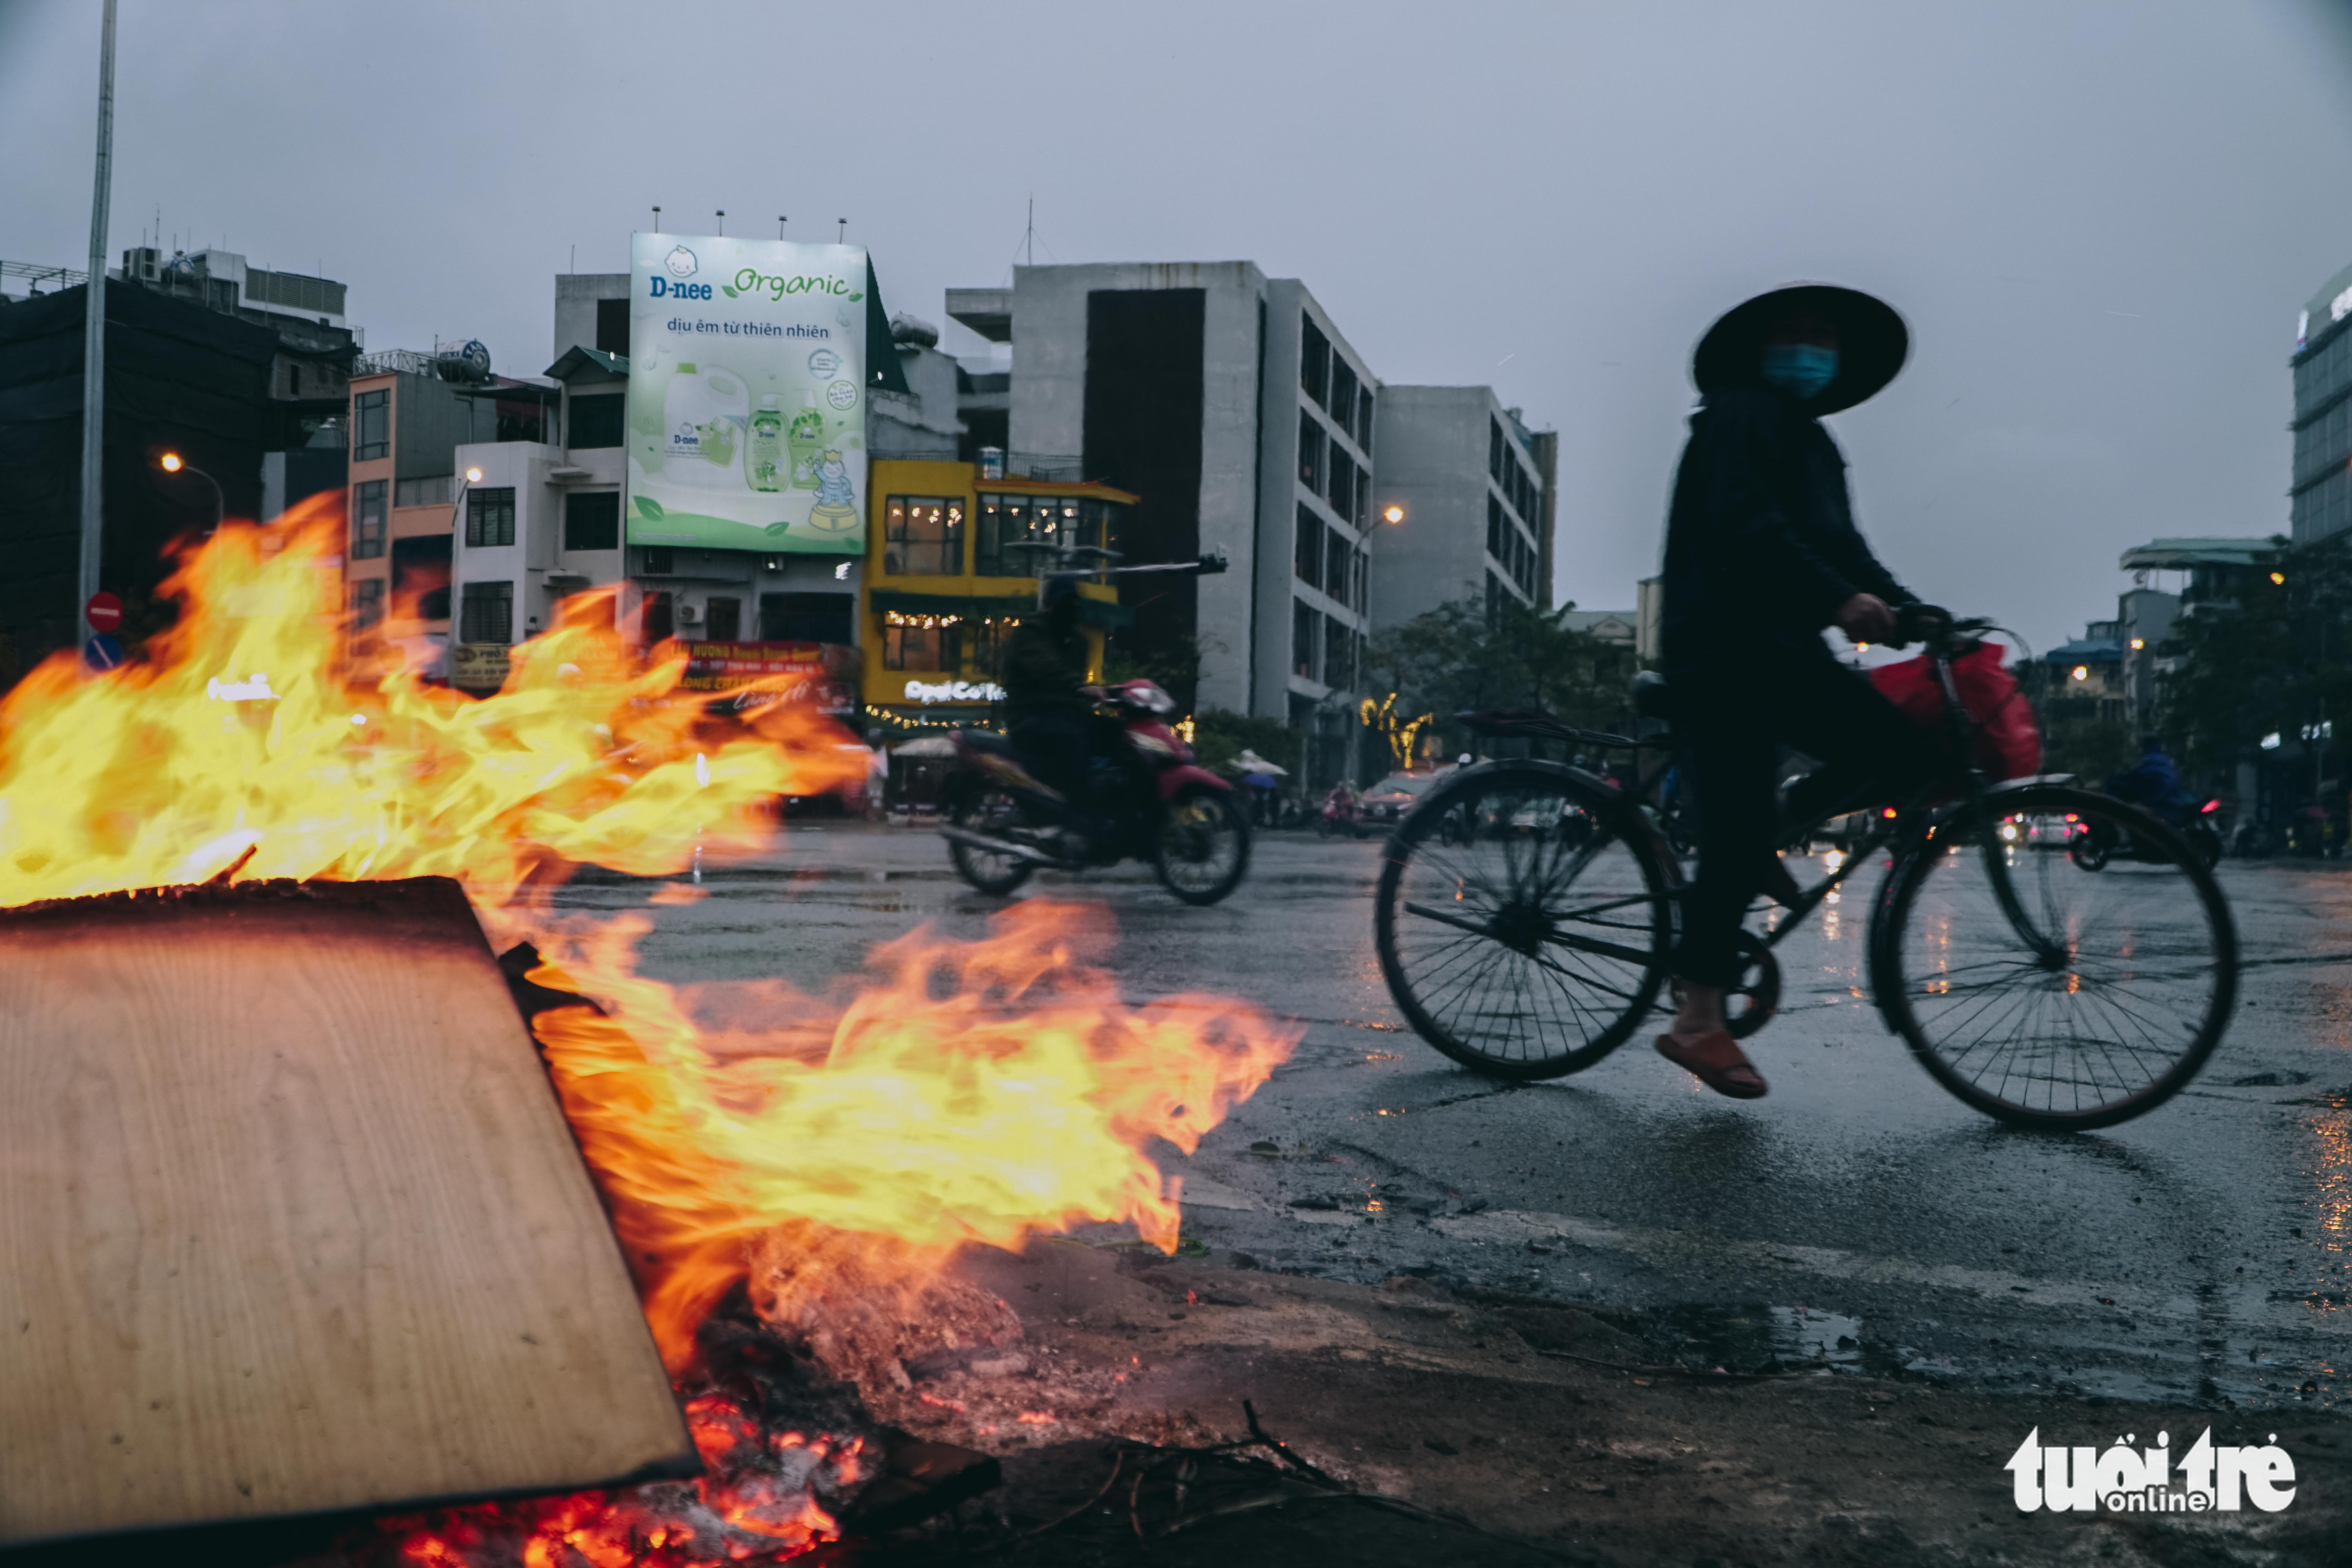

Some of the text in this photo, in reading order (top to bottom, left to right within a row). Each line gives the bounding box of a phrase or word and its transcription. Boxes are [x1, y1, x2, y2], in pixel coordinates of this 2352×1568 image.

[650, 276, 713, 300] D-nee
[735, 269, 849, 301] Organic
[667, 318, 828, 338] dịu êm từ thiên nhiên
[674, 435, 698, 445] D-nee
